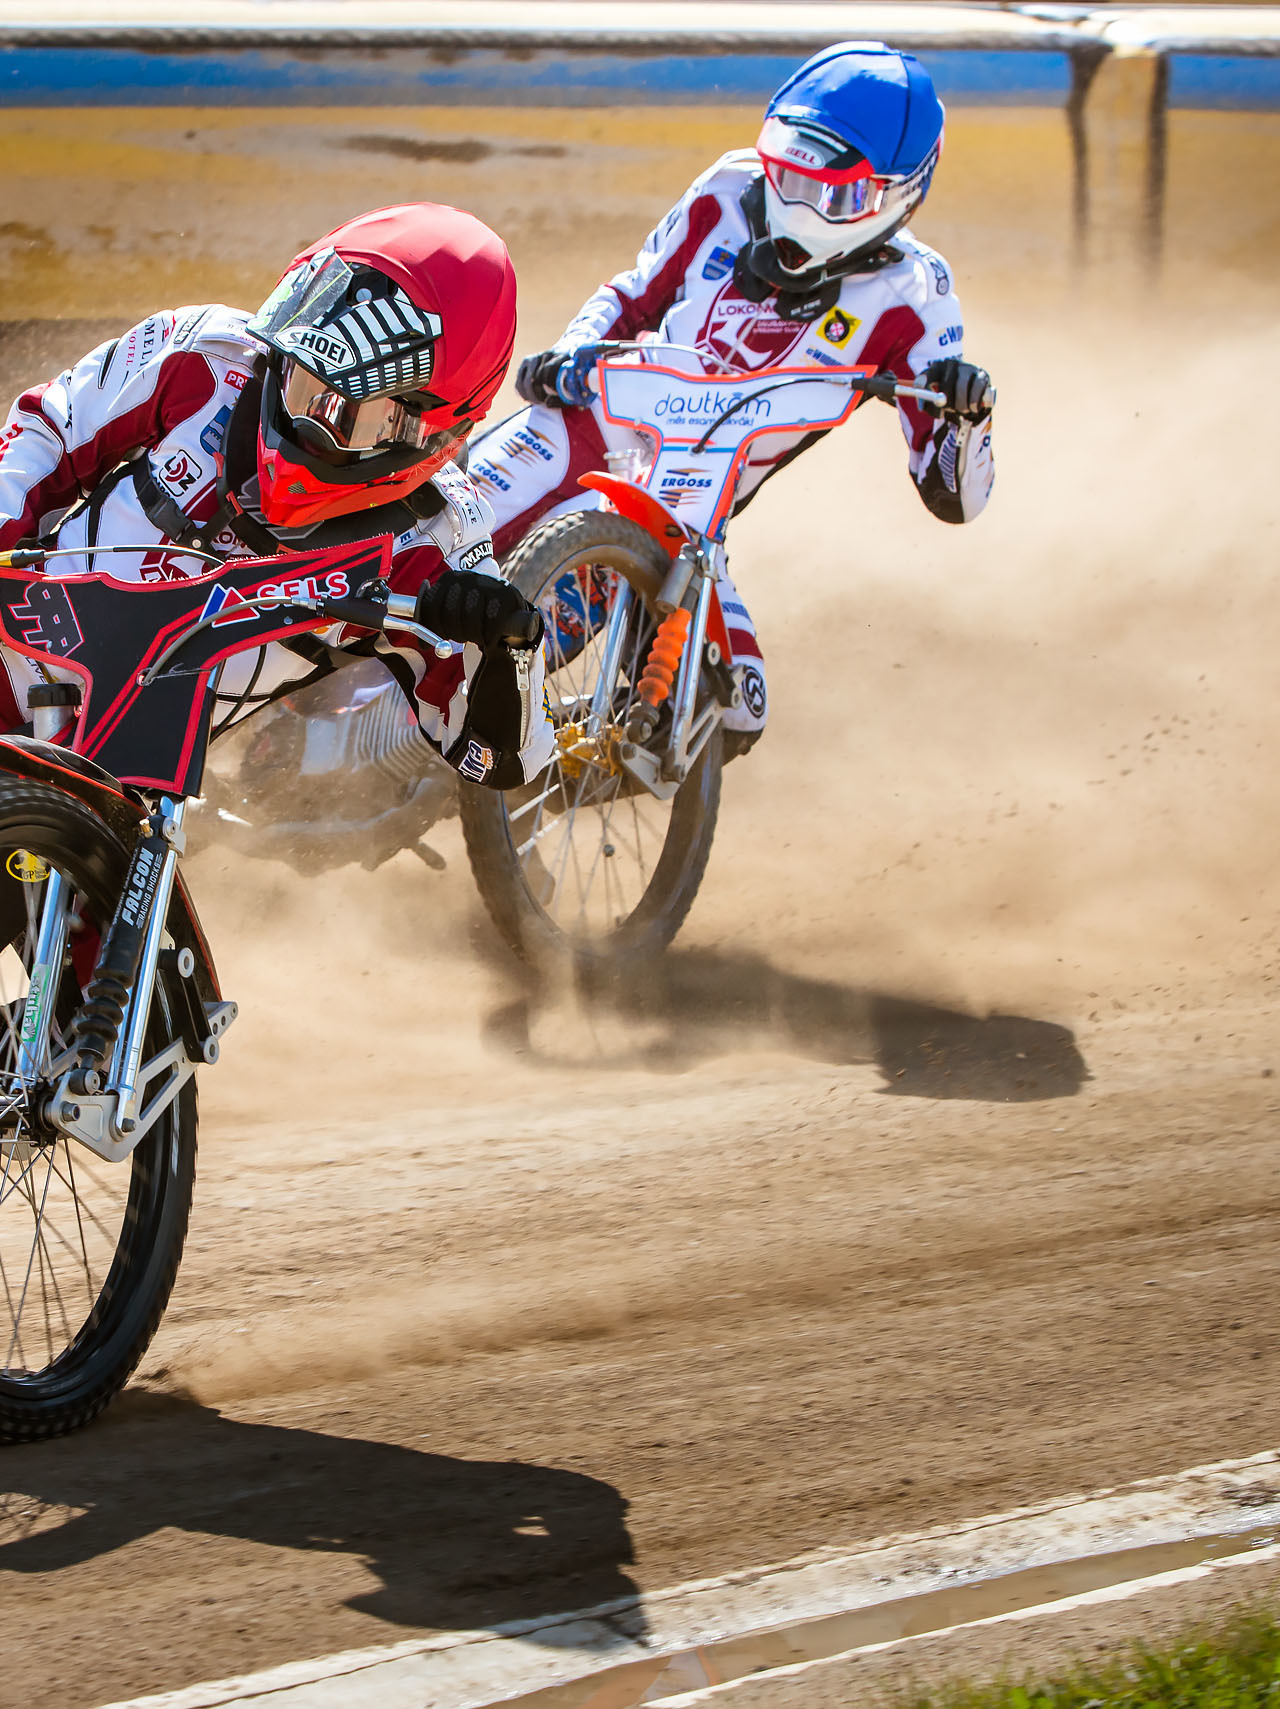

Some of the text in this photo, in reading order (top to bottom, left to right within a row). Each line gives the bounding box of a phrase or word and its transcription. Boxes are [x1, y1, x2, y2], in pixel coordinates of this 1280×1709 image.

[785, 146, 816, 165] BELL
[287, 332, 347, 365] SHOEI
[661, 478, 713, 488] ERGOSS
[121, 847, 154, 926] FALCON
[139, 893, 152, 922] RACING
